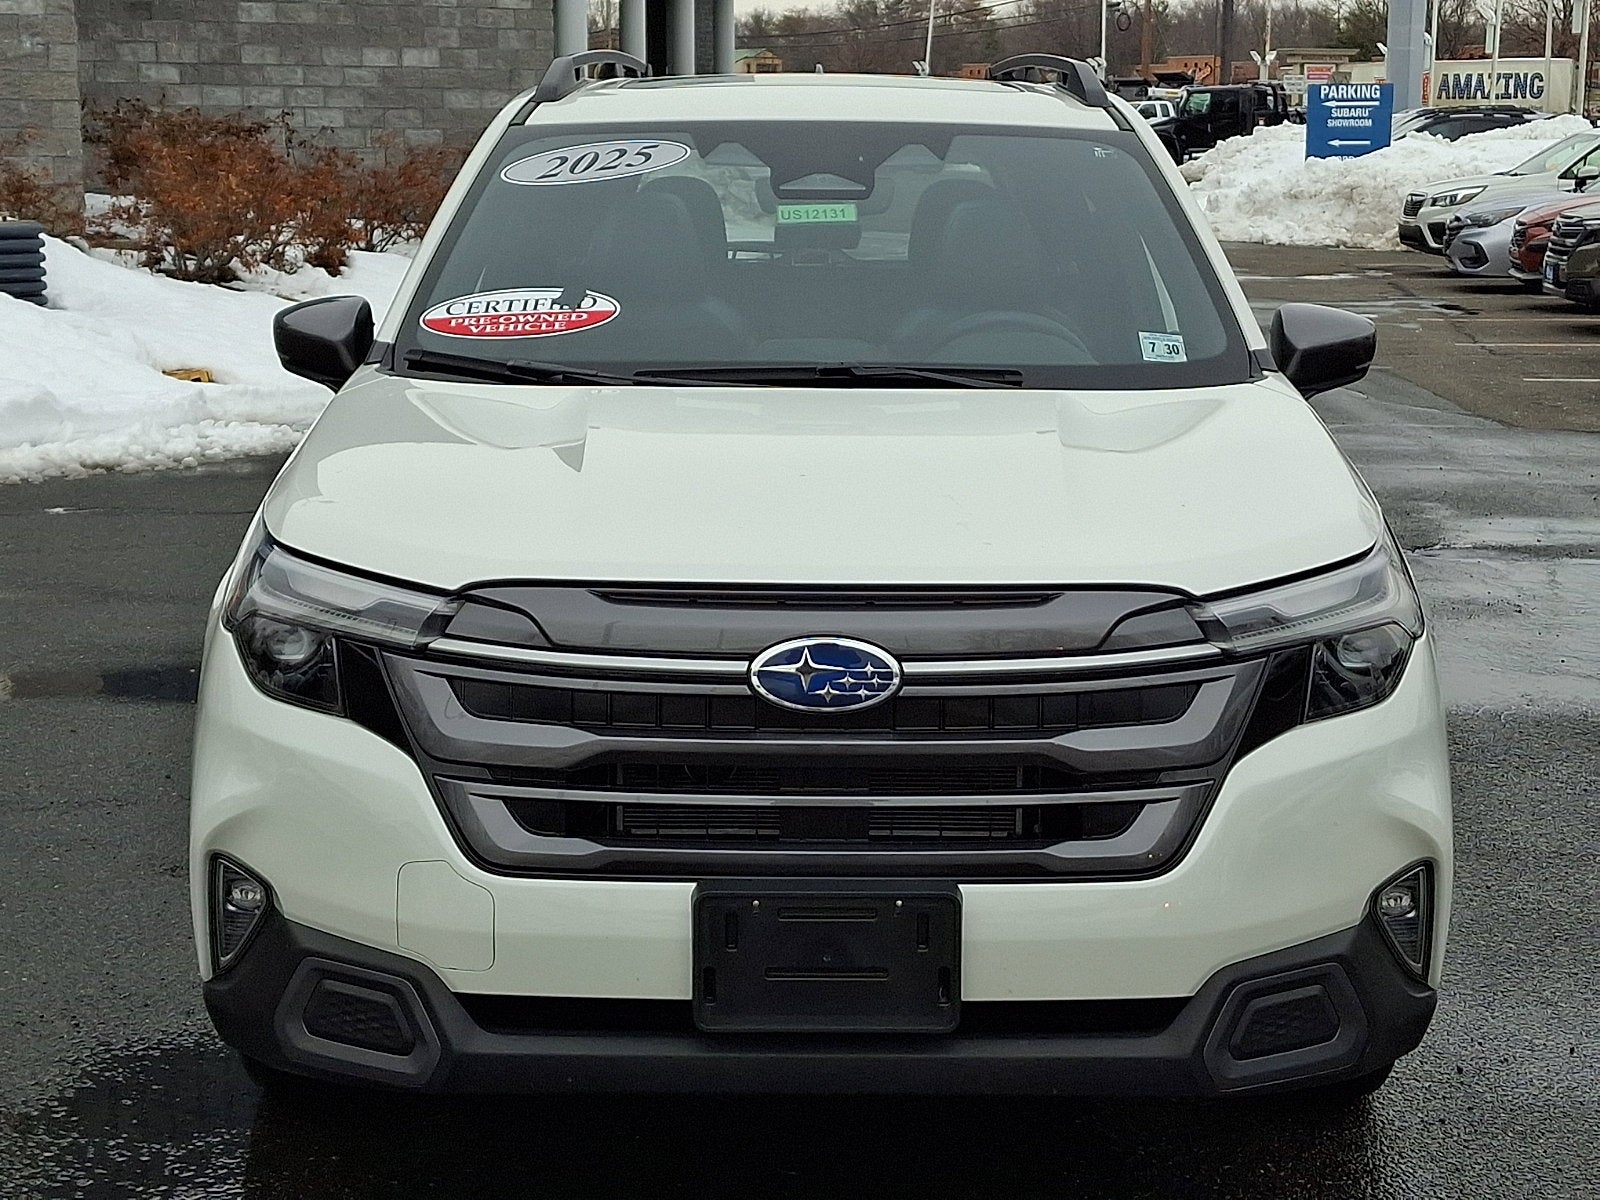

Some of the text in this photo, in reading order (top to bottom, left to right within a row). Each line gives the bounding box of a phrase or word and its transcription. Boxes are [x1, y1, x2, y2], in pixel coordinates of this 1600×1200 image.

[1320, 84, 1381, 100] PARKING
[1437, 72, 1545, 100] AMAZING
[1331, 107, 1369, 118] SUBARU
[1326, 118, 1373, 128] SHOWROOM
[535, 144, 660, 180] 2025
[780, 208, 847, 220] US12131
[449, 312, 589, 328] PRE-OWNED
[469, 321, 567, 333] VEHICLE
[1148, 341, 1180, 355] 7 30
